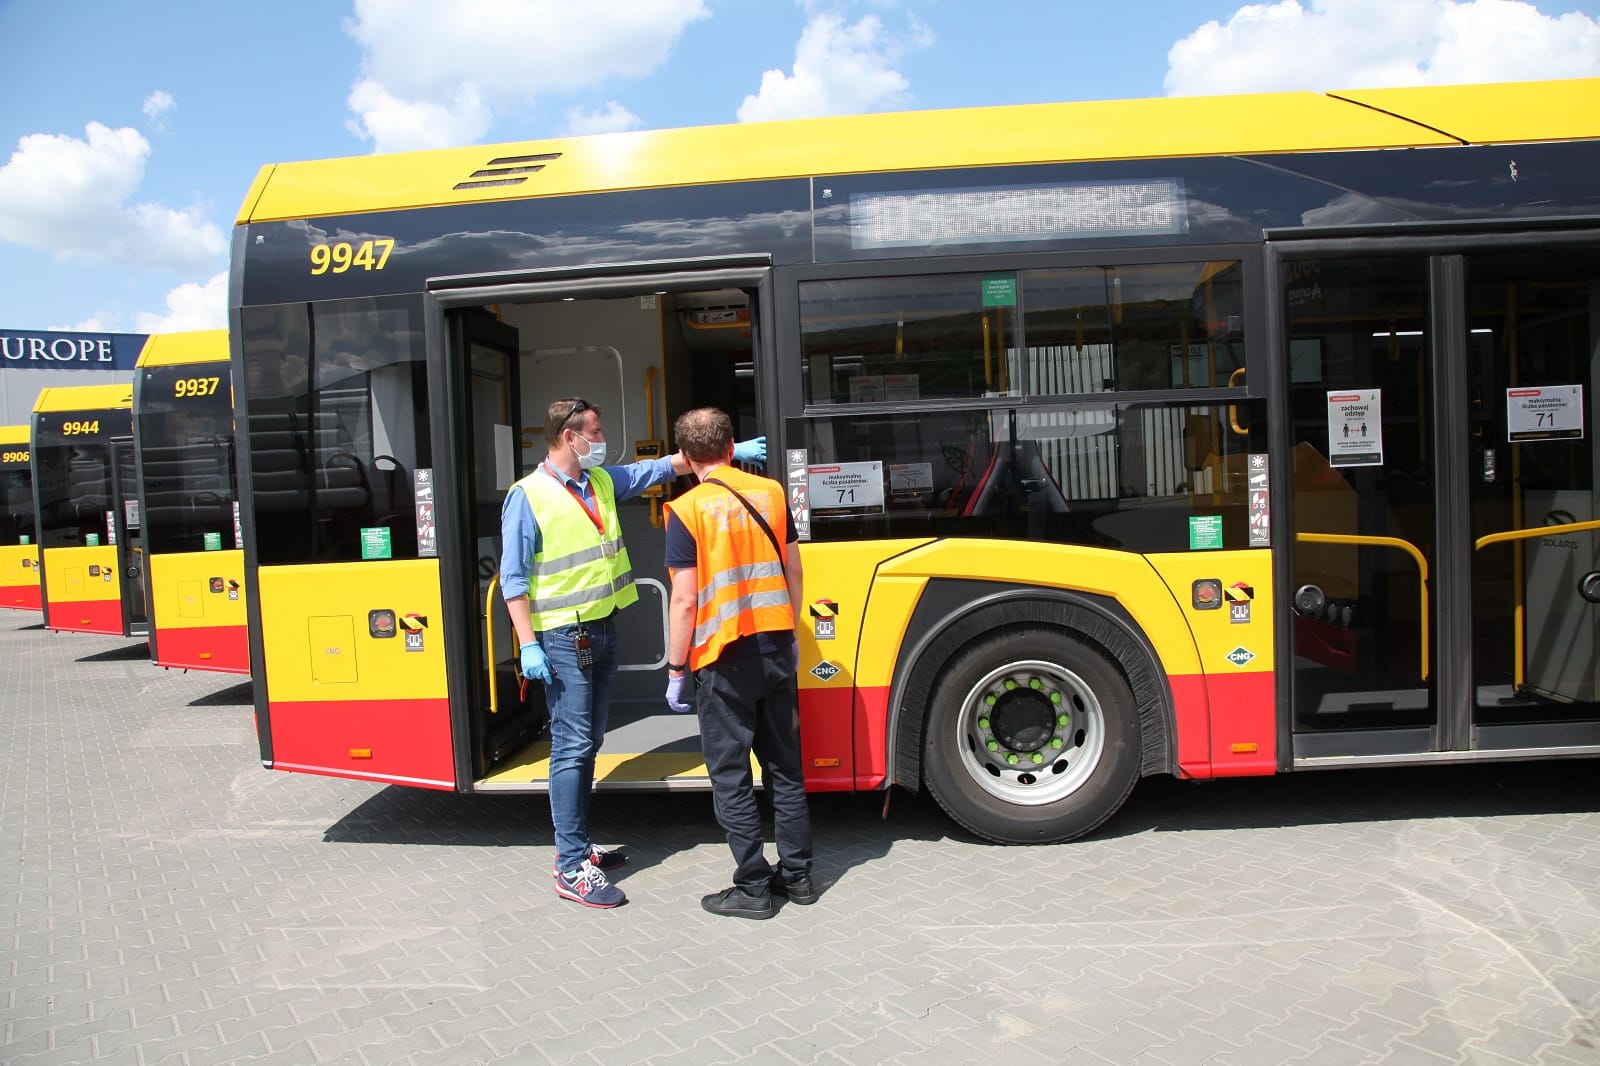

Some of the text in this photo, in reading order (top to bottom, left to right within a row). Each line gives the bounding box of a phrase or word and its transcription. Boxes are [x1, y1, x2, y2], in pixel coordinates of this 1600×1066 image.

[310, 238, 395, 275] 9947
[0, 337, 113, 362] UROPE
[174, 377, 219, 398] 9937
[1340, 404, 1369, 412] zachowaj
[1536, 412, 1555, 427] 71
[63, 420, 100, 436] 9944
[2, 451, 30, 463] 9906
[836, 489, 855, 503] 71
[1543, 538, 1578, 549] SOLARIS
[1230, 652, 1250, 661] CNG
[815, 667, 836, 675] CNG
